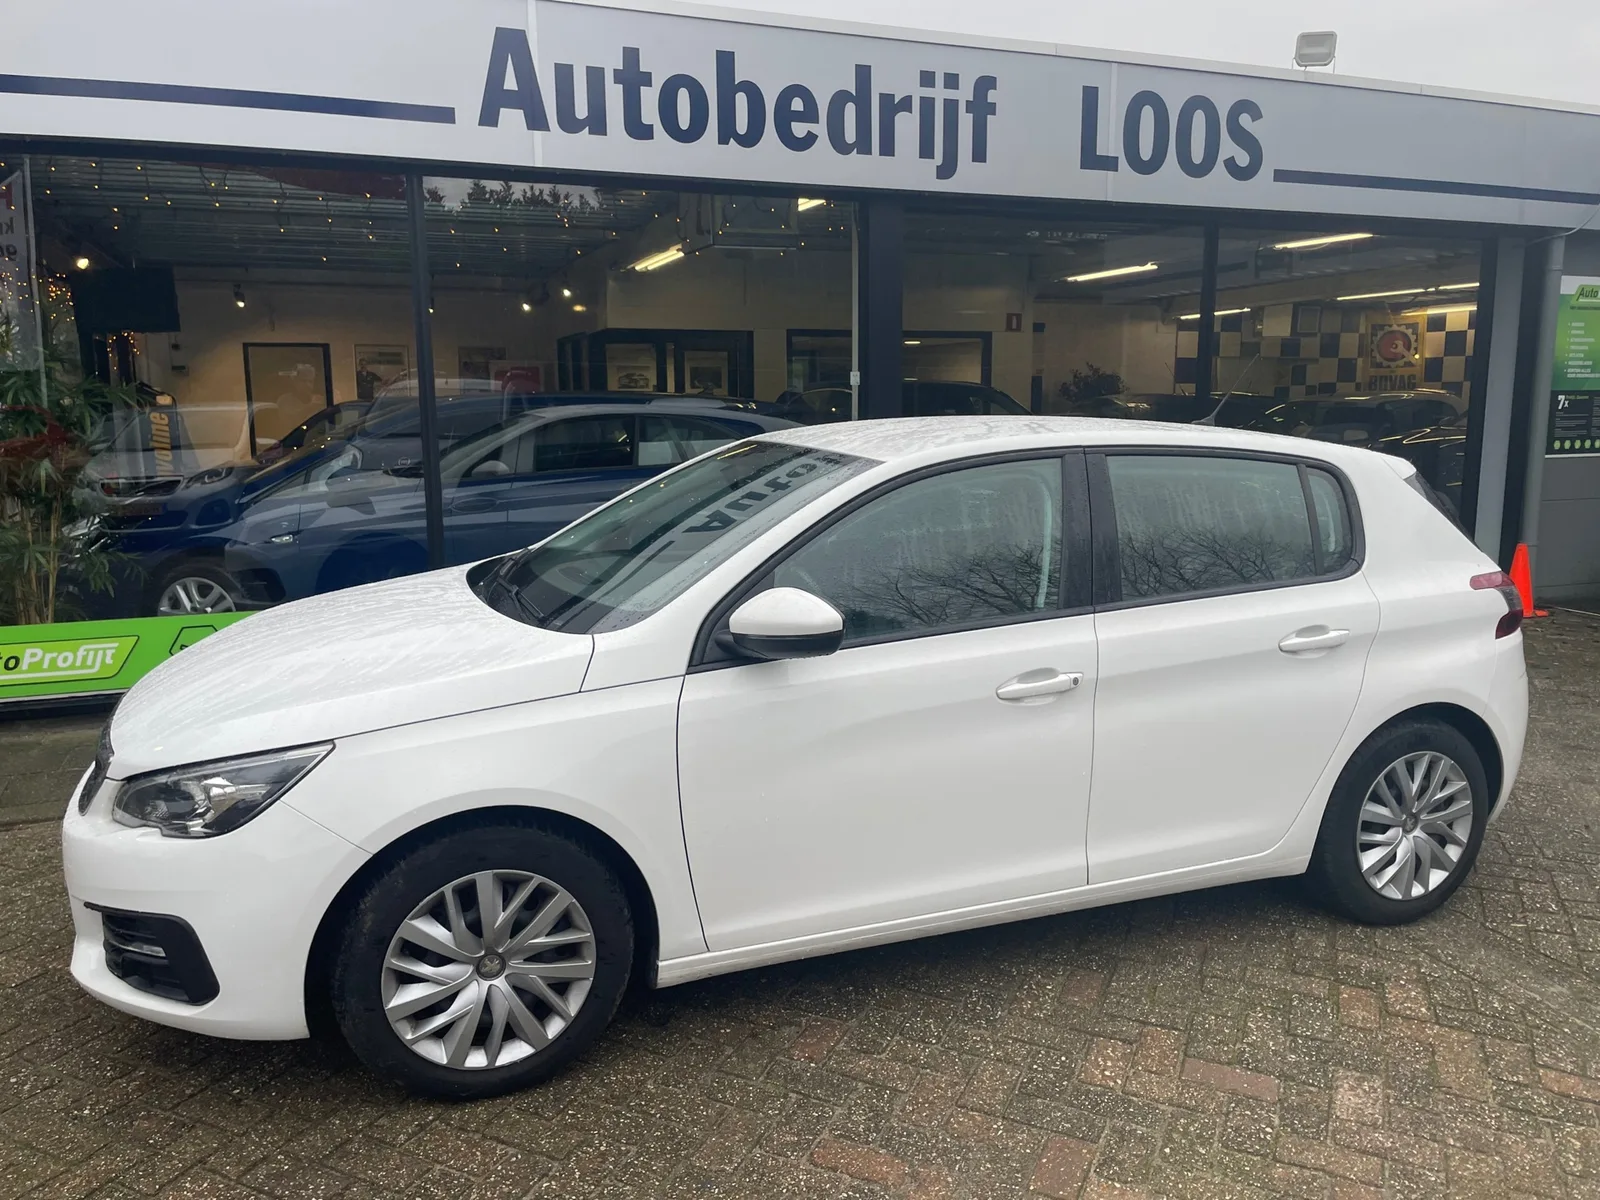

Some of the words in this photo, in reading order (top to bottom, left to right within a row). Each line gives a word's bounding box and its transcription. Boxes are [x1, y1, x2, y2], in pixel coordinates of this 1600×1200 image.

[478, 27, 997, 180] Autobedrijf
[1080, 85, 1263, 181] LOOS
[1576, 286, 1600, 302] Auto
[0, 643, 119, 674] oProfijt
